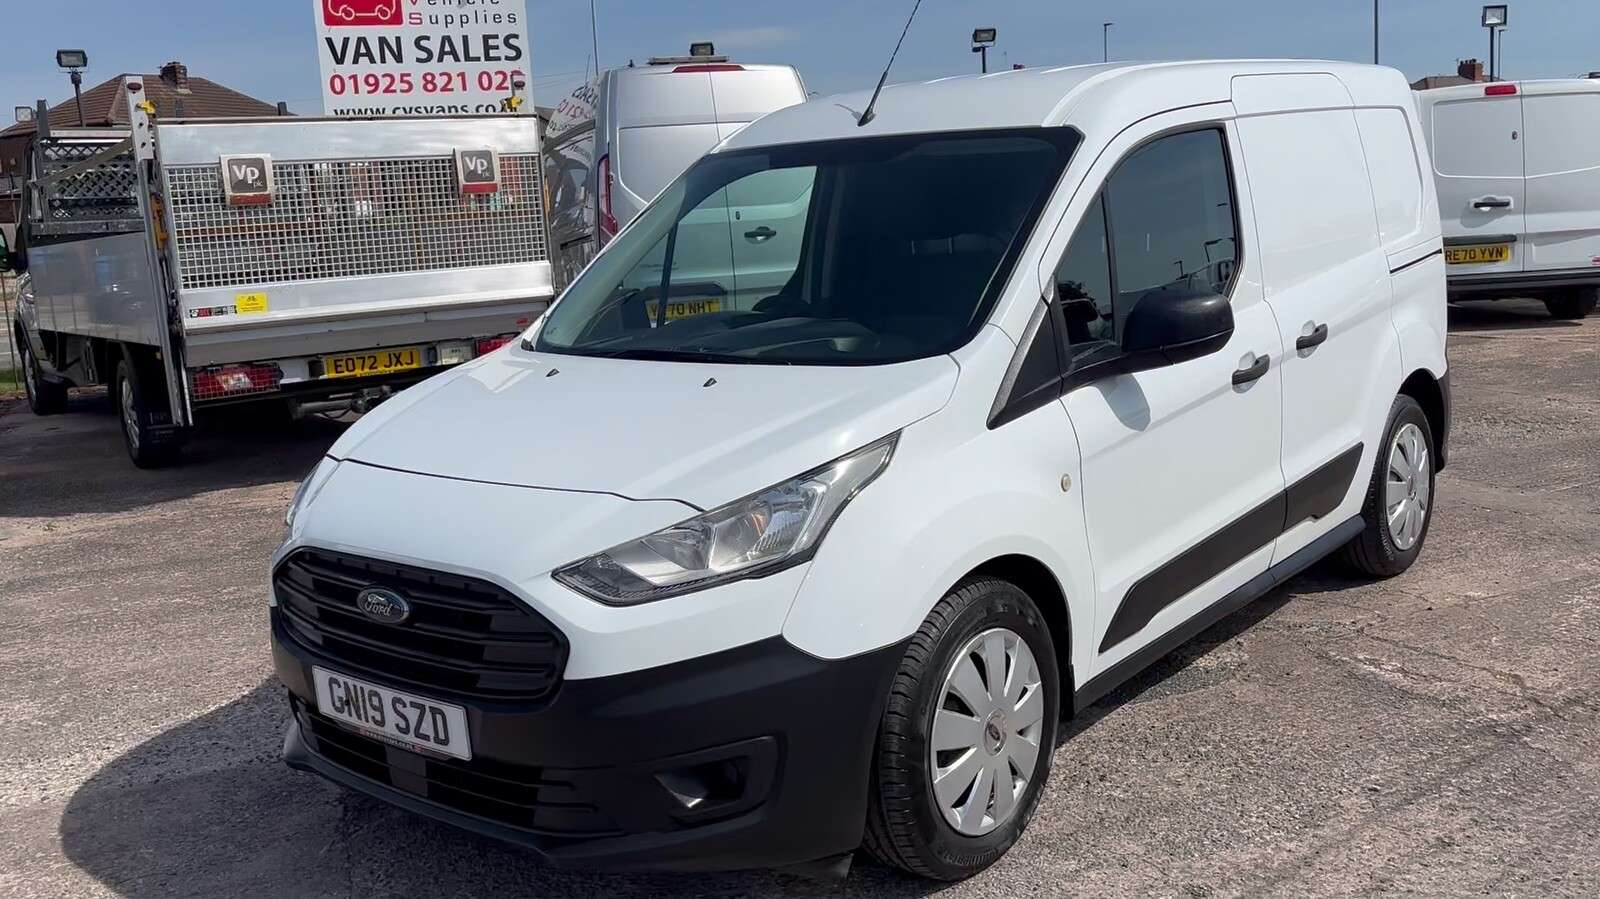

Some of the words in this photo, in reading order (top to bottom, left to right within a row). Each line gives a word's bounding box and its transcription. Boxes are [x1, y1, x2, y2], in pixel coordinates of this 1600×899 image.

[408, 10, 518, 28] Supplies
[325, 35, 404, 65] VAN
[413, 33, 523, 63] SALES
[329, 72, 414, 95] 01925
[421, 71, 468, 93] 821
[1445, 249, 1477, 261] RE70
[1480, 247, 1503, 259] YVN
[688, 300, 712, 314] NHT
[333, 354, 378, 375] EO72
[381, 349, 416, 370] JXJ
[364, 592, 394, 616] Ford
[328, 675, 386, 728] GN19
[390, 695, 450, 747] SZD
